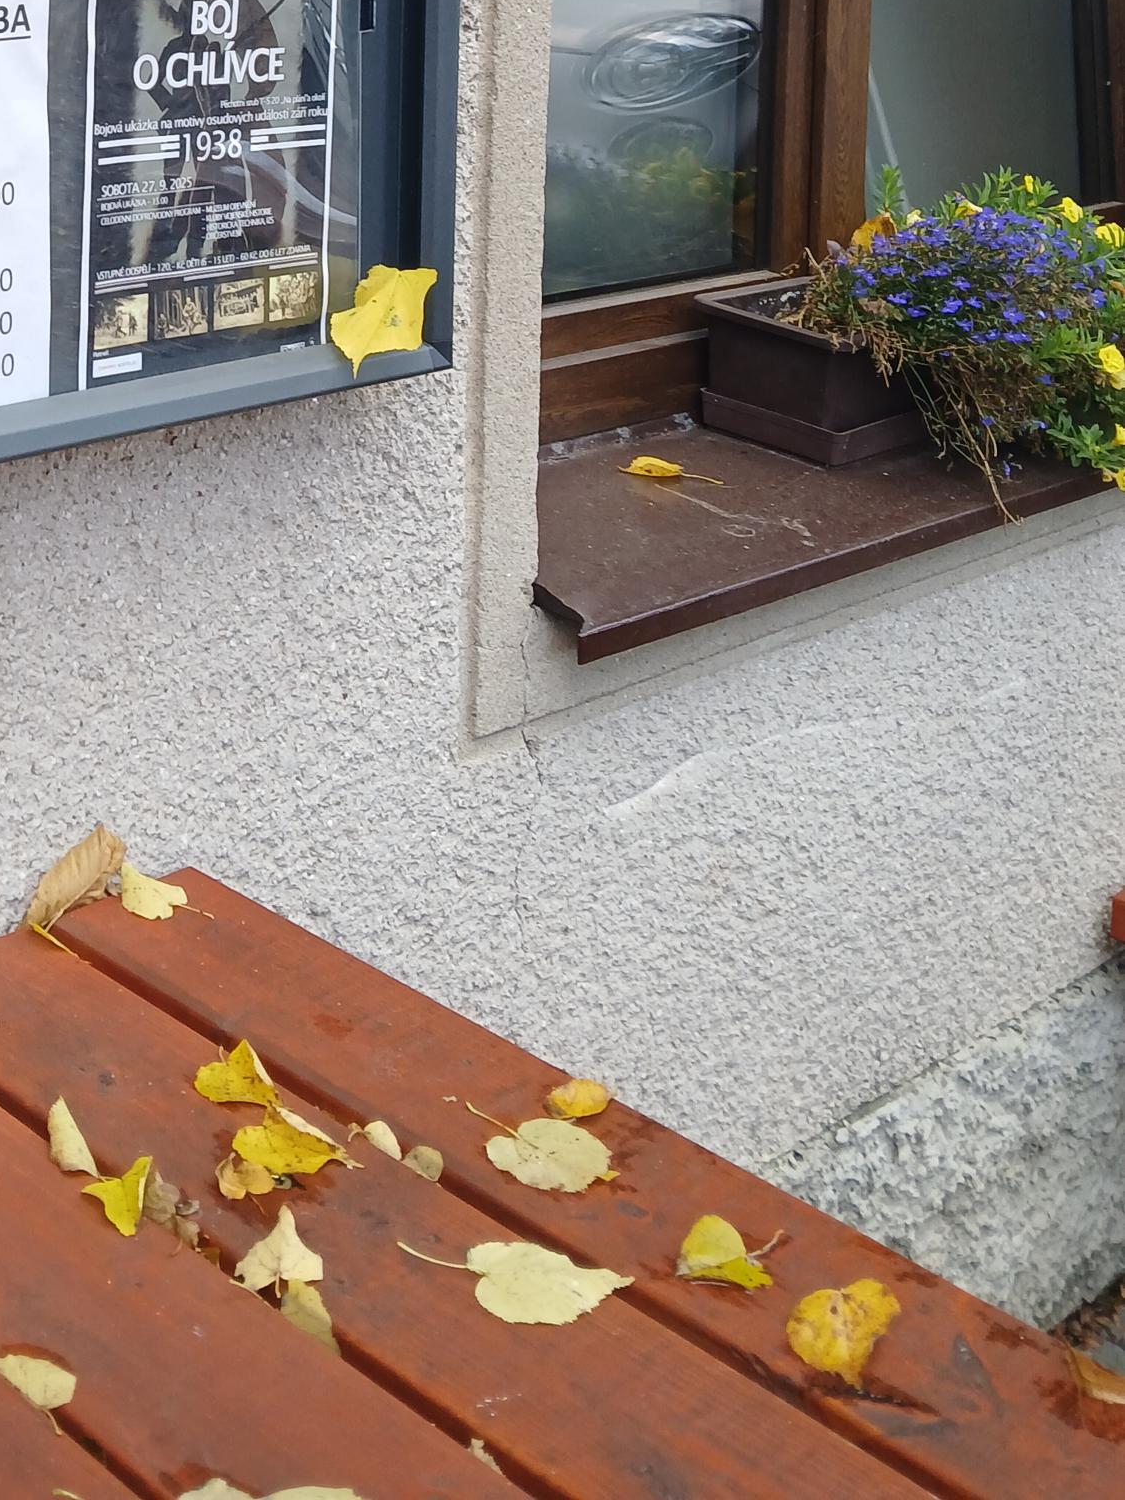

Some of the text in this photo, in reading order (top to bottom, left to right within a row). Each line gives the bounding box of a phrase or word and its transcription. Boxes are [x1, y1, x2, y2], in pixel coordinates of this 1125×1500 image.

[191, 0, 239, 39] BOJ
[133, 41, 285, 90] O CHLÍVCE
[94, 120, 123, 137] Bojová
[124, 118, 158, 132] ukázka
[161, 119, 172, 129] na
[174, 115, 205, 128] motivy
[206, 110, 254, 125] osudových
[182, 128, 242, 162] 1938
[101, 182, 140, 198] SOBOTA
[170, 176, 193, 190] 2025
